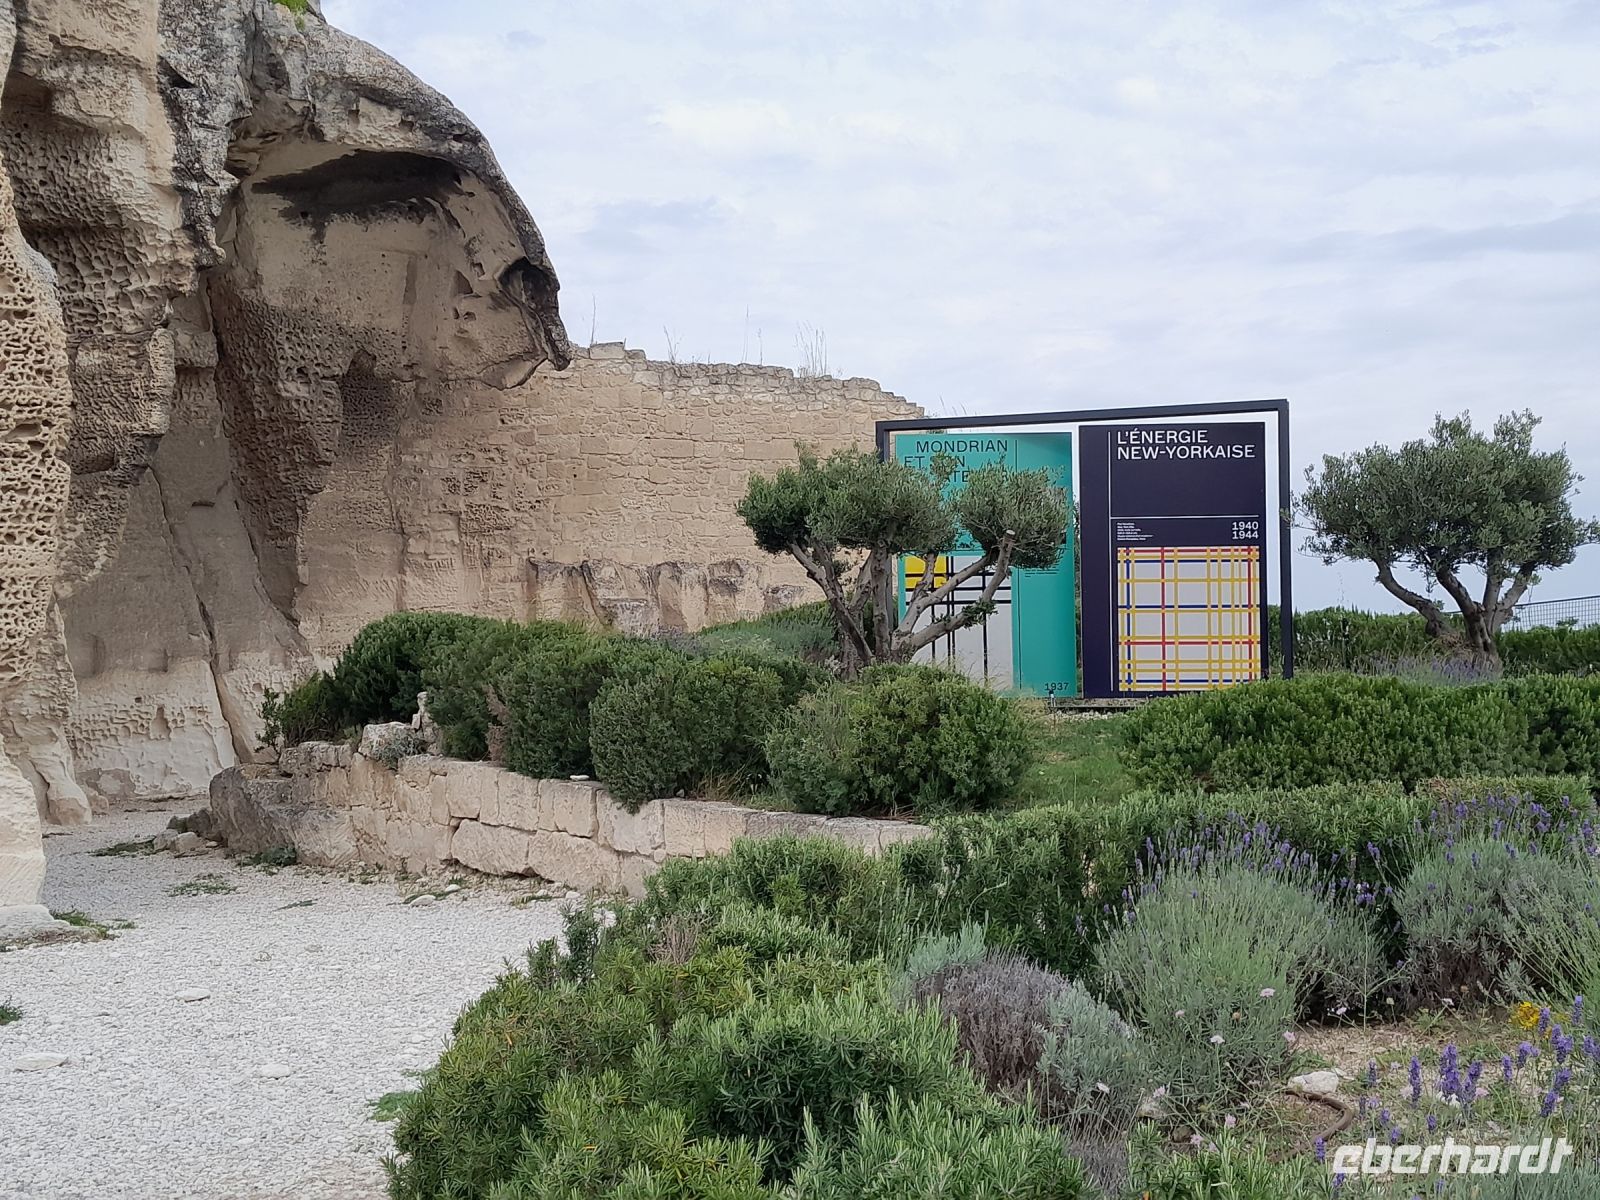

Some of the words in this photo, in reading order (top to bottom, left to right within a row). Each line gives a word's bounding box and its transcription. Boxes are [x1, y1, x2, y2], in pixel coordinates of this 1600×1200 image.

[1117, 427, 1208, 444] L'ÉNERGIE
[916, 440, 1008, 453] MONDRIAN
[1117, 444, 1256, 460] NEW-YORKAISE
[904, 456, 926, 468] ET
[1231, 521, 1259, 530] 1940
[1231, 530, 1259, 540] 1944
[1044, 682, 1069, 691] 1937
